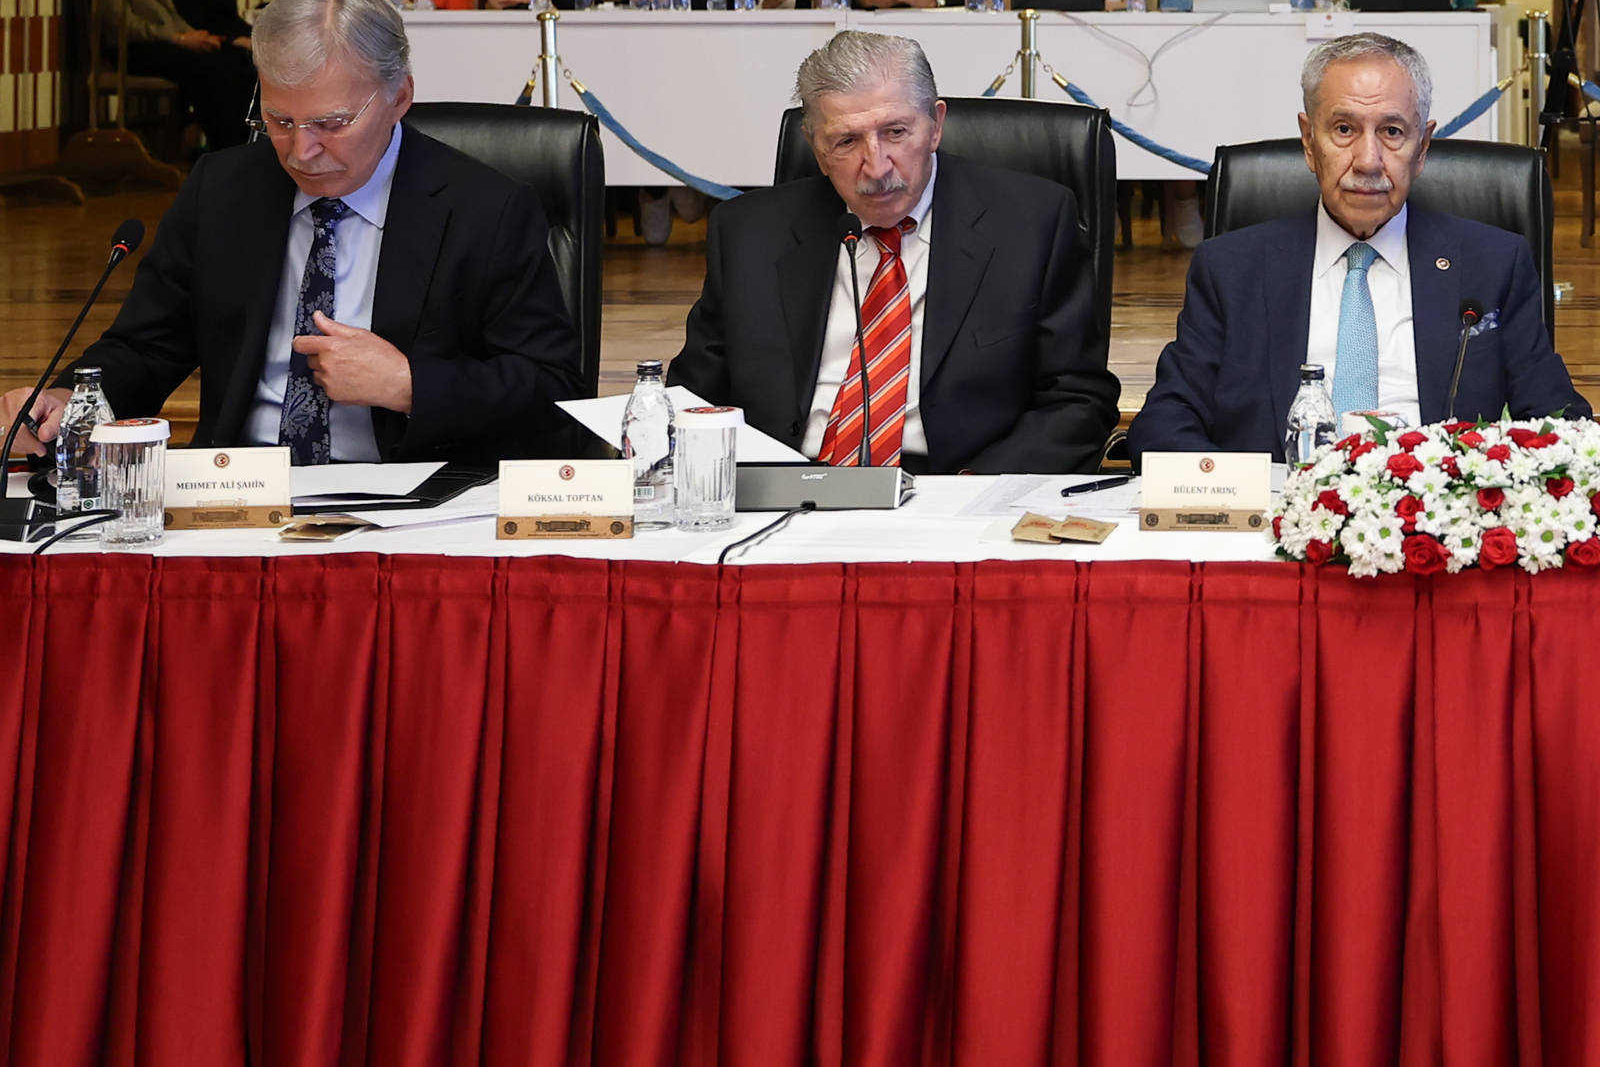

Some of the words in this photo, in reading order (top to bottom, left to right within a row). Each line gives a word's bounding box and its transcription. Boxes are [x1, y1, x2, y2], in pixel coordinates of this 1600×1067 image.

[176, 482, 217, 490] MEHMET
[219, 480, 234, 490] ALİ
[236, 480, 265, 490] ŞAHİN
[1173, 485, 1207, 494] BÜLENT
[1210, 486, 1238, 496] ARINÇ
[527, 493, 563, 502] KÖKSAL
[567, 494, 604, 502] TOPTAN
